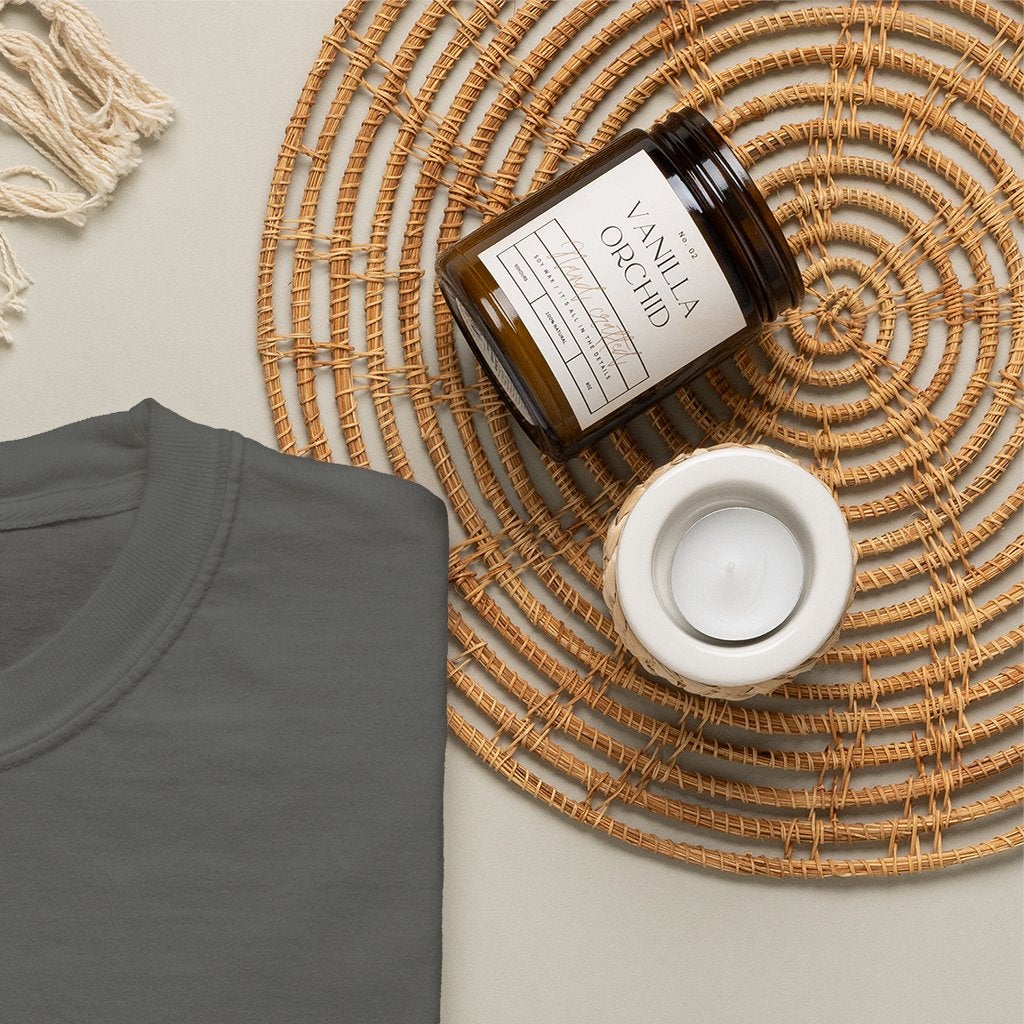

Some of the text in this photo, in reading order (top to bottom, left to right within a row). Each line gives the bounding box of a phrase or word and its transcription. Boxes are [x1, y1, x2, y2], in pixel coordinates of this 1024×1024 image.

[600, 225, 670, 327] ORCHID
[627, 200, 700, 318] VANILLA
[688, 248, 698, 260] 02
[534, 254, 544, 267] SOY
[544, 269, 555, 283] WAX
[558, 291, 570, 306] IT'S
[569, 309, 578, 322] ALL
[578, 324, 586, 334] IN
[585, 335, 595, 349] THE
[593, 351, 611, 380] DETAILS
[553, 323, 567, 345] NATURAL
